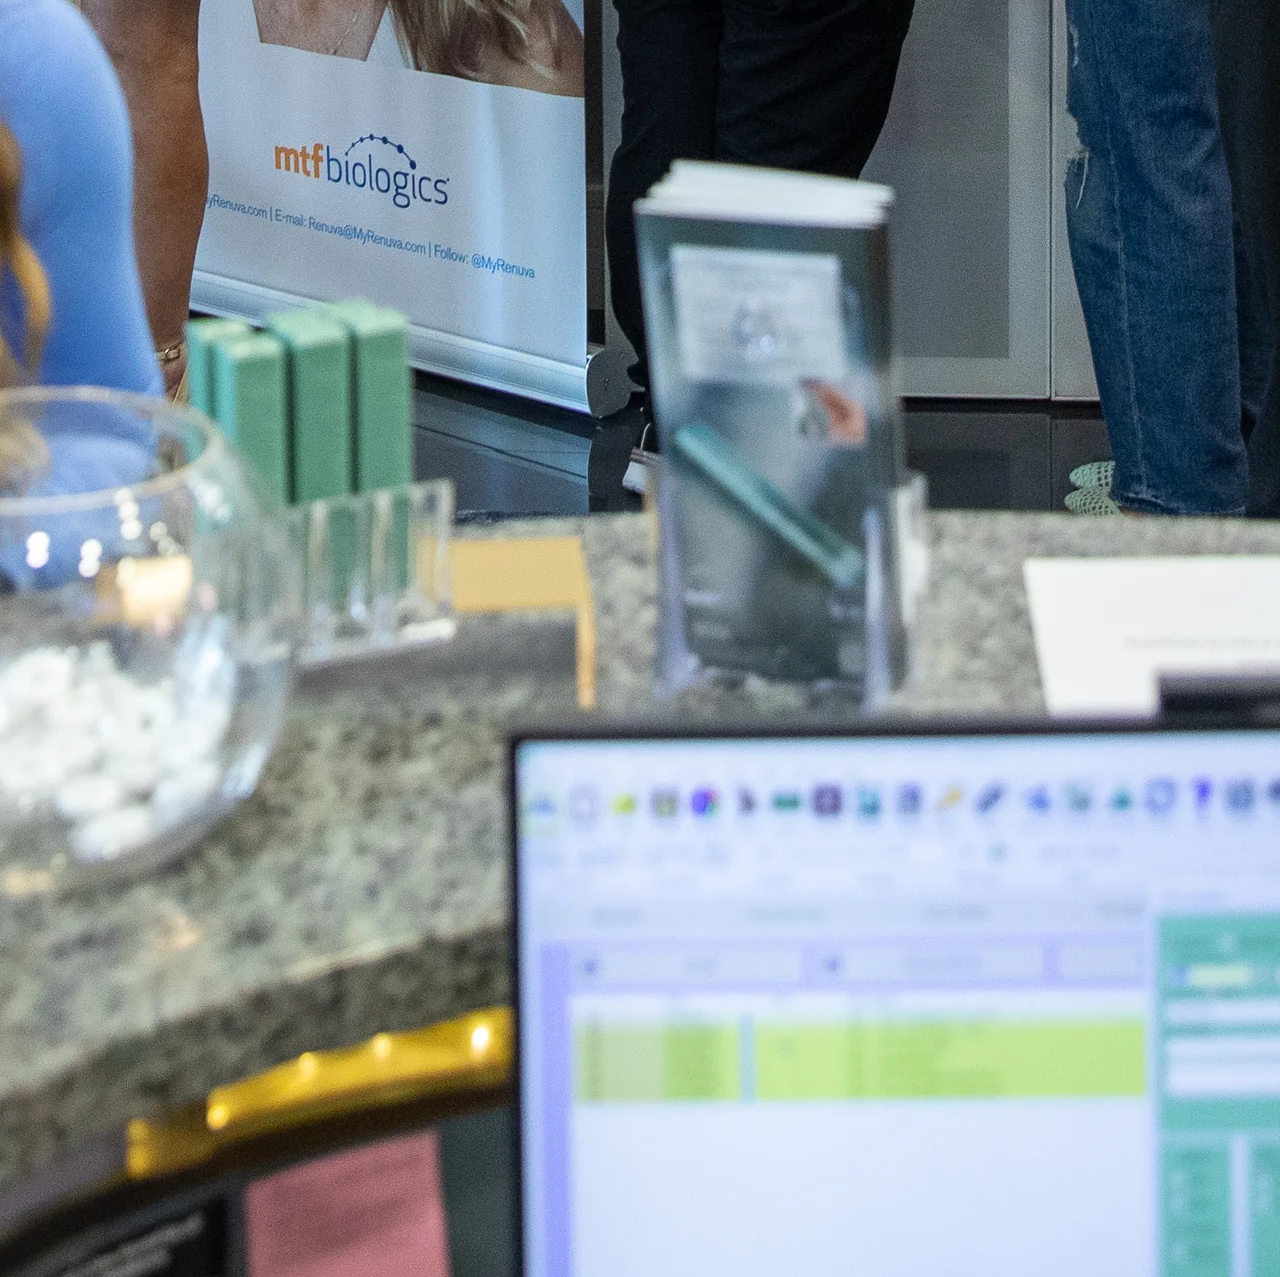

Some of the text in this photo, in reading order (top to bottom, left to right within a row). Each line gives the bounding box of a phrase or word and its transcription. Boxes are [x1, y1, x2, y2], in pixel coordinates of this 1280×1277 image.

[204, 193, 536, 279] yRenuva.com E-mail: Renuva@MyRenuva.com Follow: @MyRenuva
